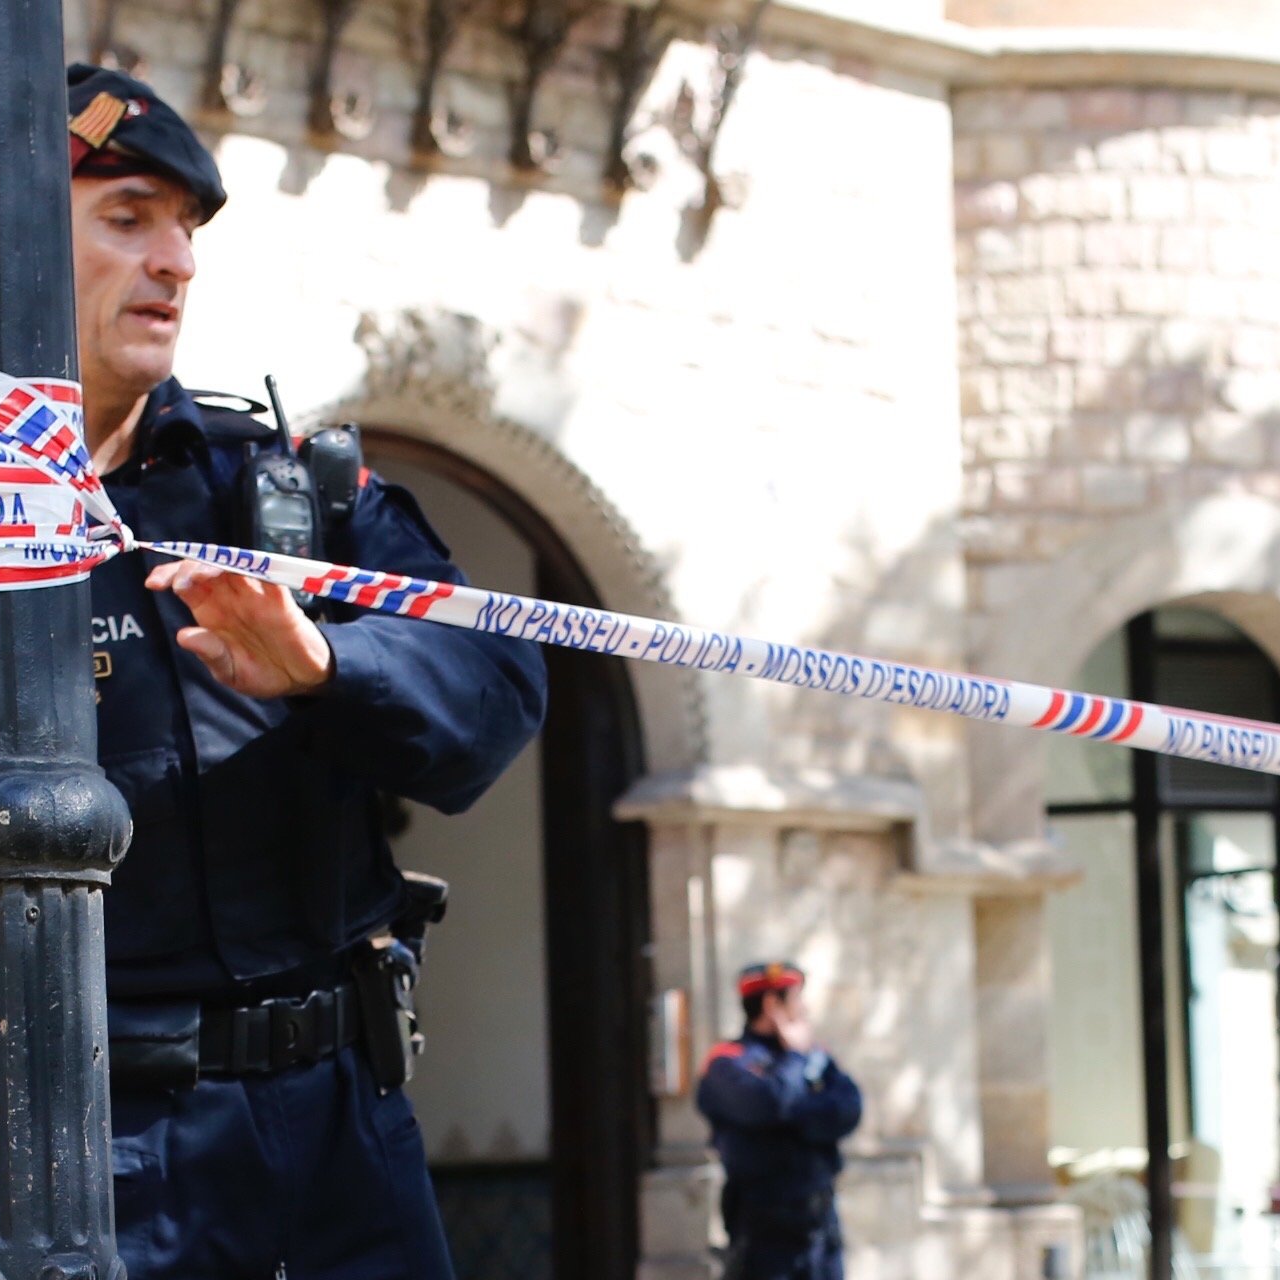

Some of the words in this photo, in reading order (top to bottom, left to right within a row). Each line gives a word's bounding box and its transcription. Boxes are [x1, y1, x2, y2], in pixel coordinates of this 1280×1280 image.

[91, 613, 145, 644] CIA
[475, 592, 521, 632] NO
[521, 602, 629, 654] PASSEU
[647, 623, 743, 674] POLICIA
[757, 642, 863, 695] MOSSOS
[1163, 717, 1198, 754] NO
